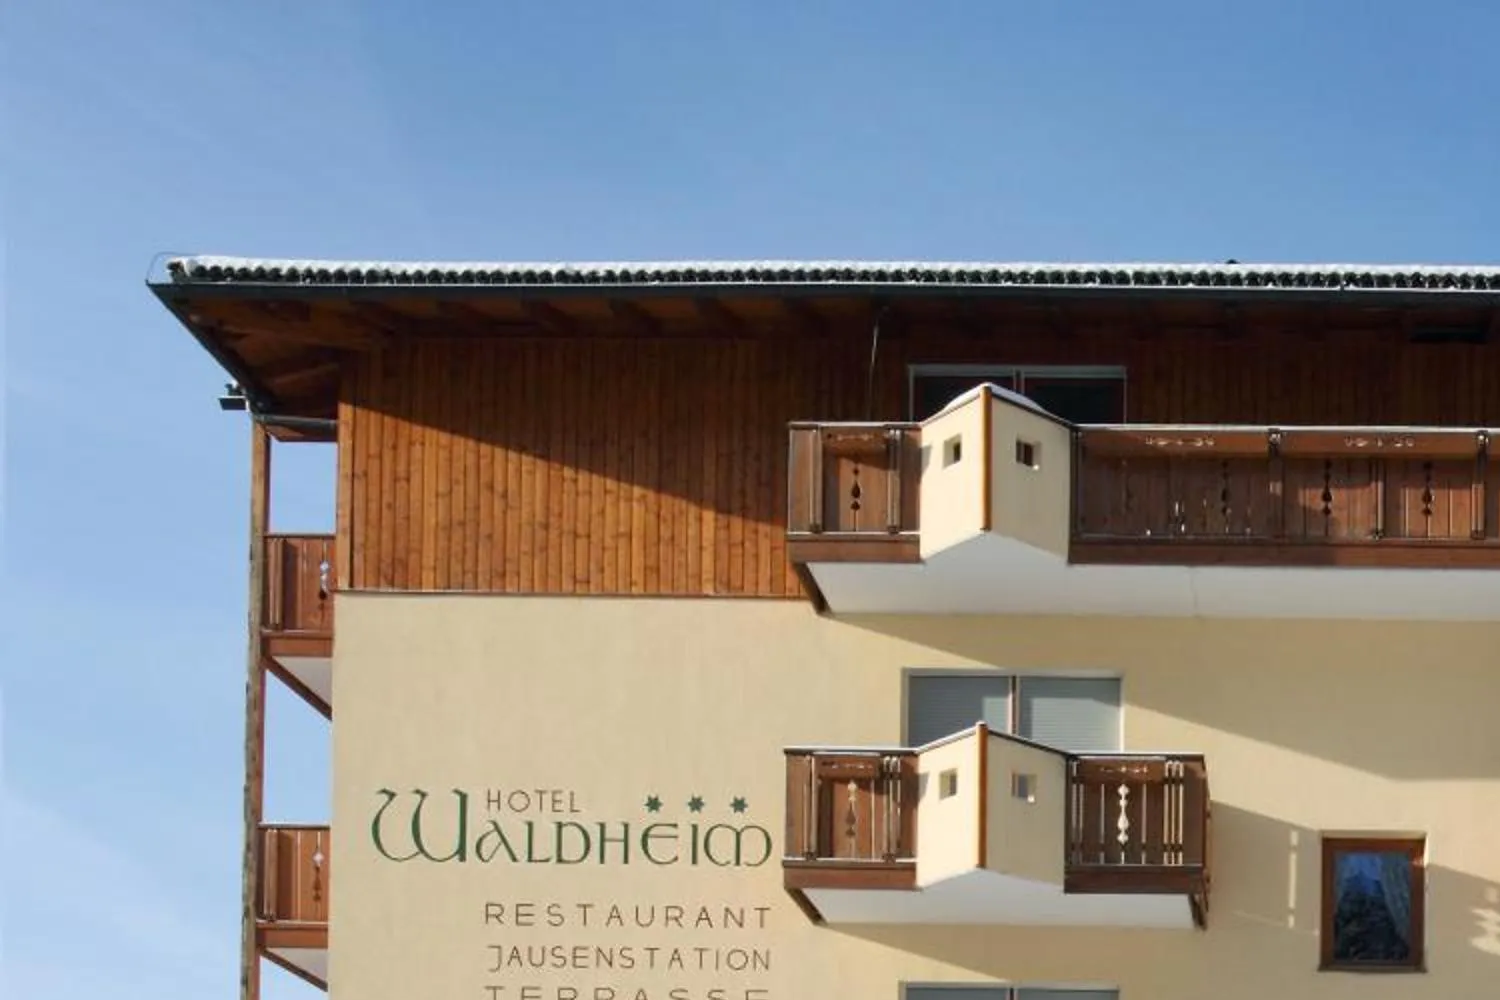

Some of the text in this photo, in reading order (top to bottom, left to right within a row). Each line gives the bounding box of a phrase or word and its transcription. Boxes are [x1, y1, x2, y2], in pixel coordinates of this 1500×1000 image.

[487, 789, 581, 813] HOTEL
[485, 903, 771, 929] RESTAURANT
[487, 945, 770, 972] JAUSENSTATION
